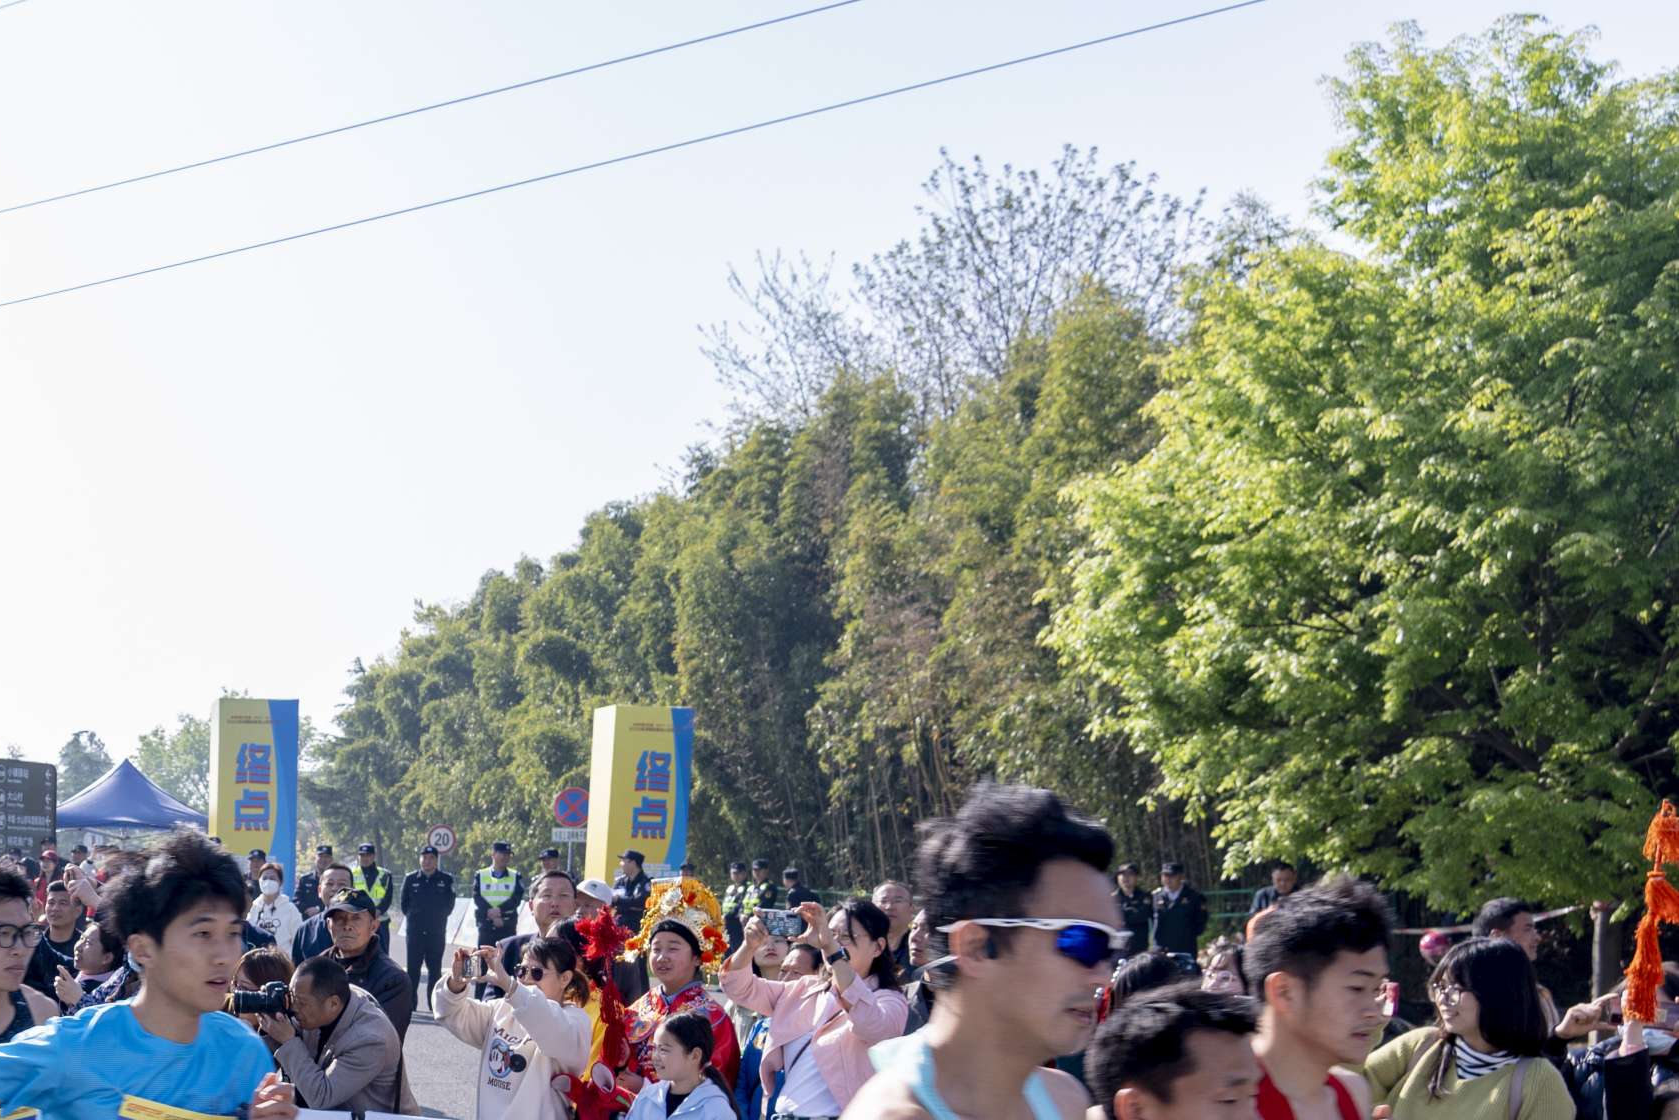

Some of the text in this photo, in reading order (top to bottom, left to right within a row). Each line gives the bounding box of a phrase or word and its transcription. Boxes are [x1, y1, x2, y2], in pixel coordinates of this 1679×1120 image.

[234, 742, 272, 831] 终点
[631, 750, 672, 839] 终点
[434, 832, 450, 846] 20
[487, 1076, 512, 1091] MOUSE
